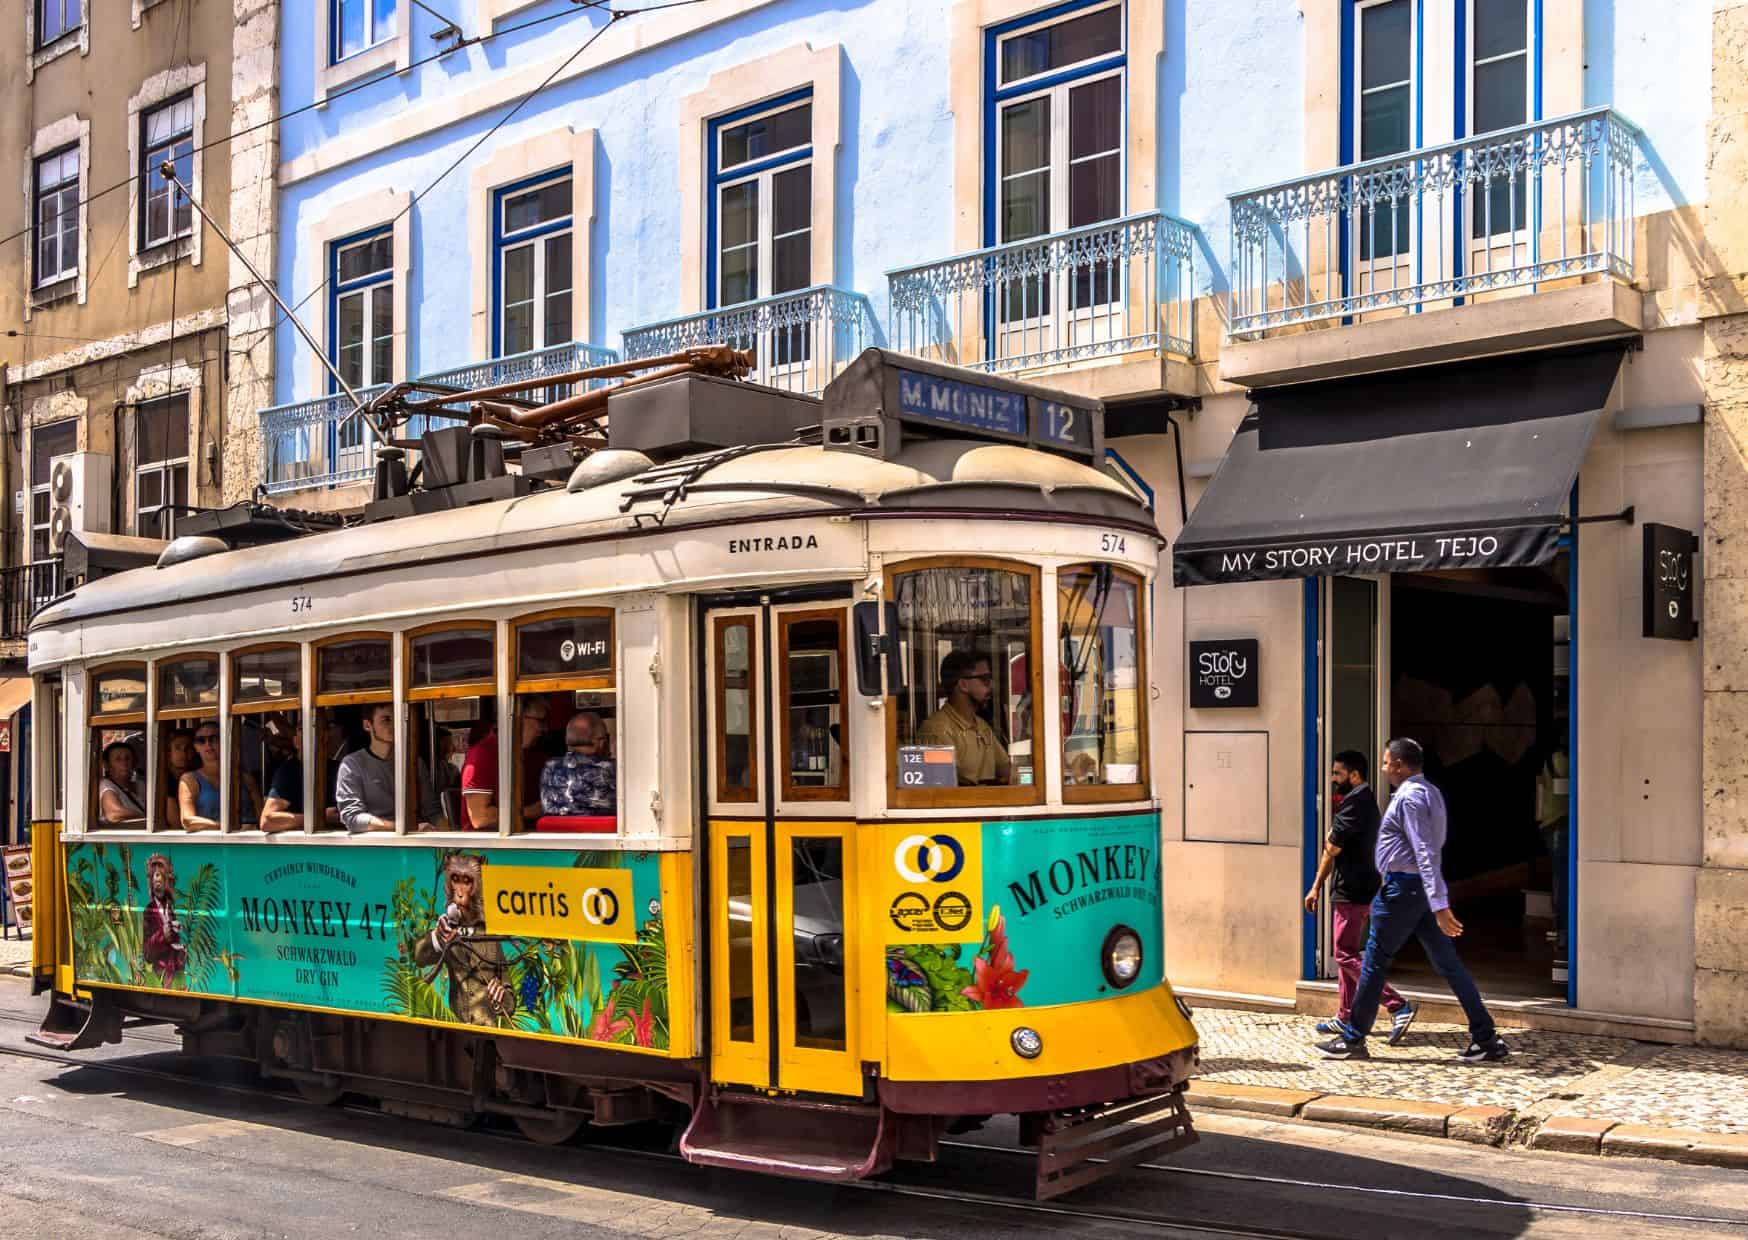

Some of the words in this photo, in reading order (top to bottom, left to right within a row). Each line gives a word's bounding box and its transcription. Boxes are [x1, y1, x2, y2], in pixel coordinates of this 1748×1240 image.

[1047, 403, 1075, 441] 12
[729, 535, 818, 553] ENTRADA
[1102, 534, 1125, 554] 574
[1221, 553, 1255, 572] MY
[1265, 546, 1338, 569] STORY
[1346, 541, 1424, 563] HOTEL
[1435, 536, 1498, 557] TEJO
[292, 596, 312, 612] 574
[577, 640, 605, 656] WI-FI
[1199, 675, 1235, 686] HOTEL
[904, 754, 923, 763] 12E
[904, 771, 924, 784] 02
[1008, 845, 1150, 916] MONKEY
[497, 882, 569, 917] carris
[1053, 886, 1131, 919] SCHWARZWALD
[241, 897, 352, 938] MONKEY
[360, 902, 388, 941] 47
[277, 945, 357, 966] SCHWARZWALD
[296, 968, 315, 984] DRY
[319, 970, 339, 987] GIN
